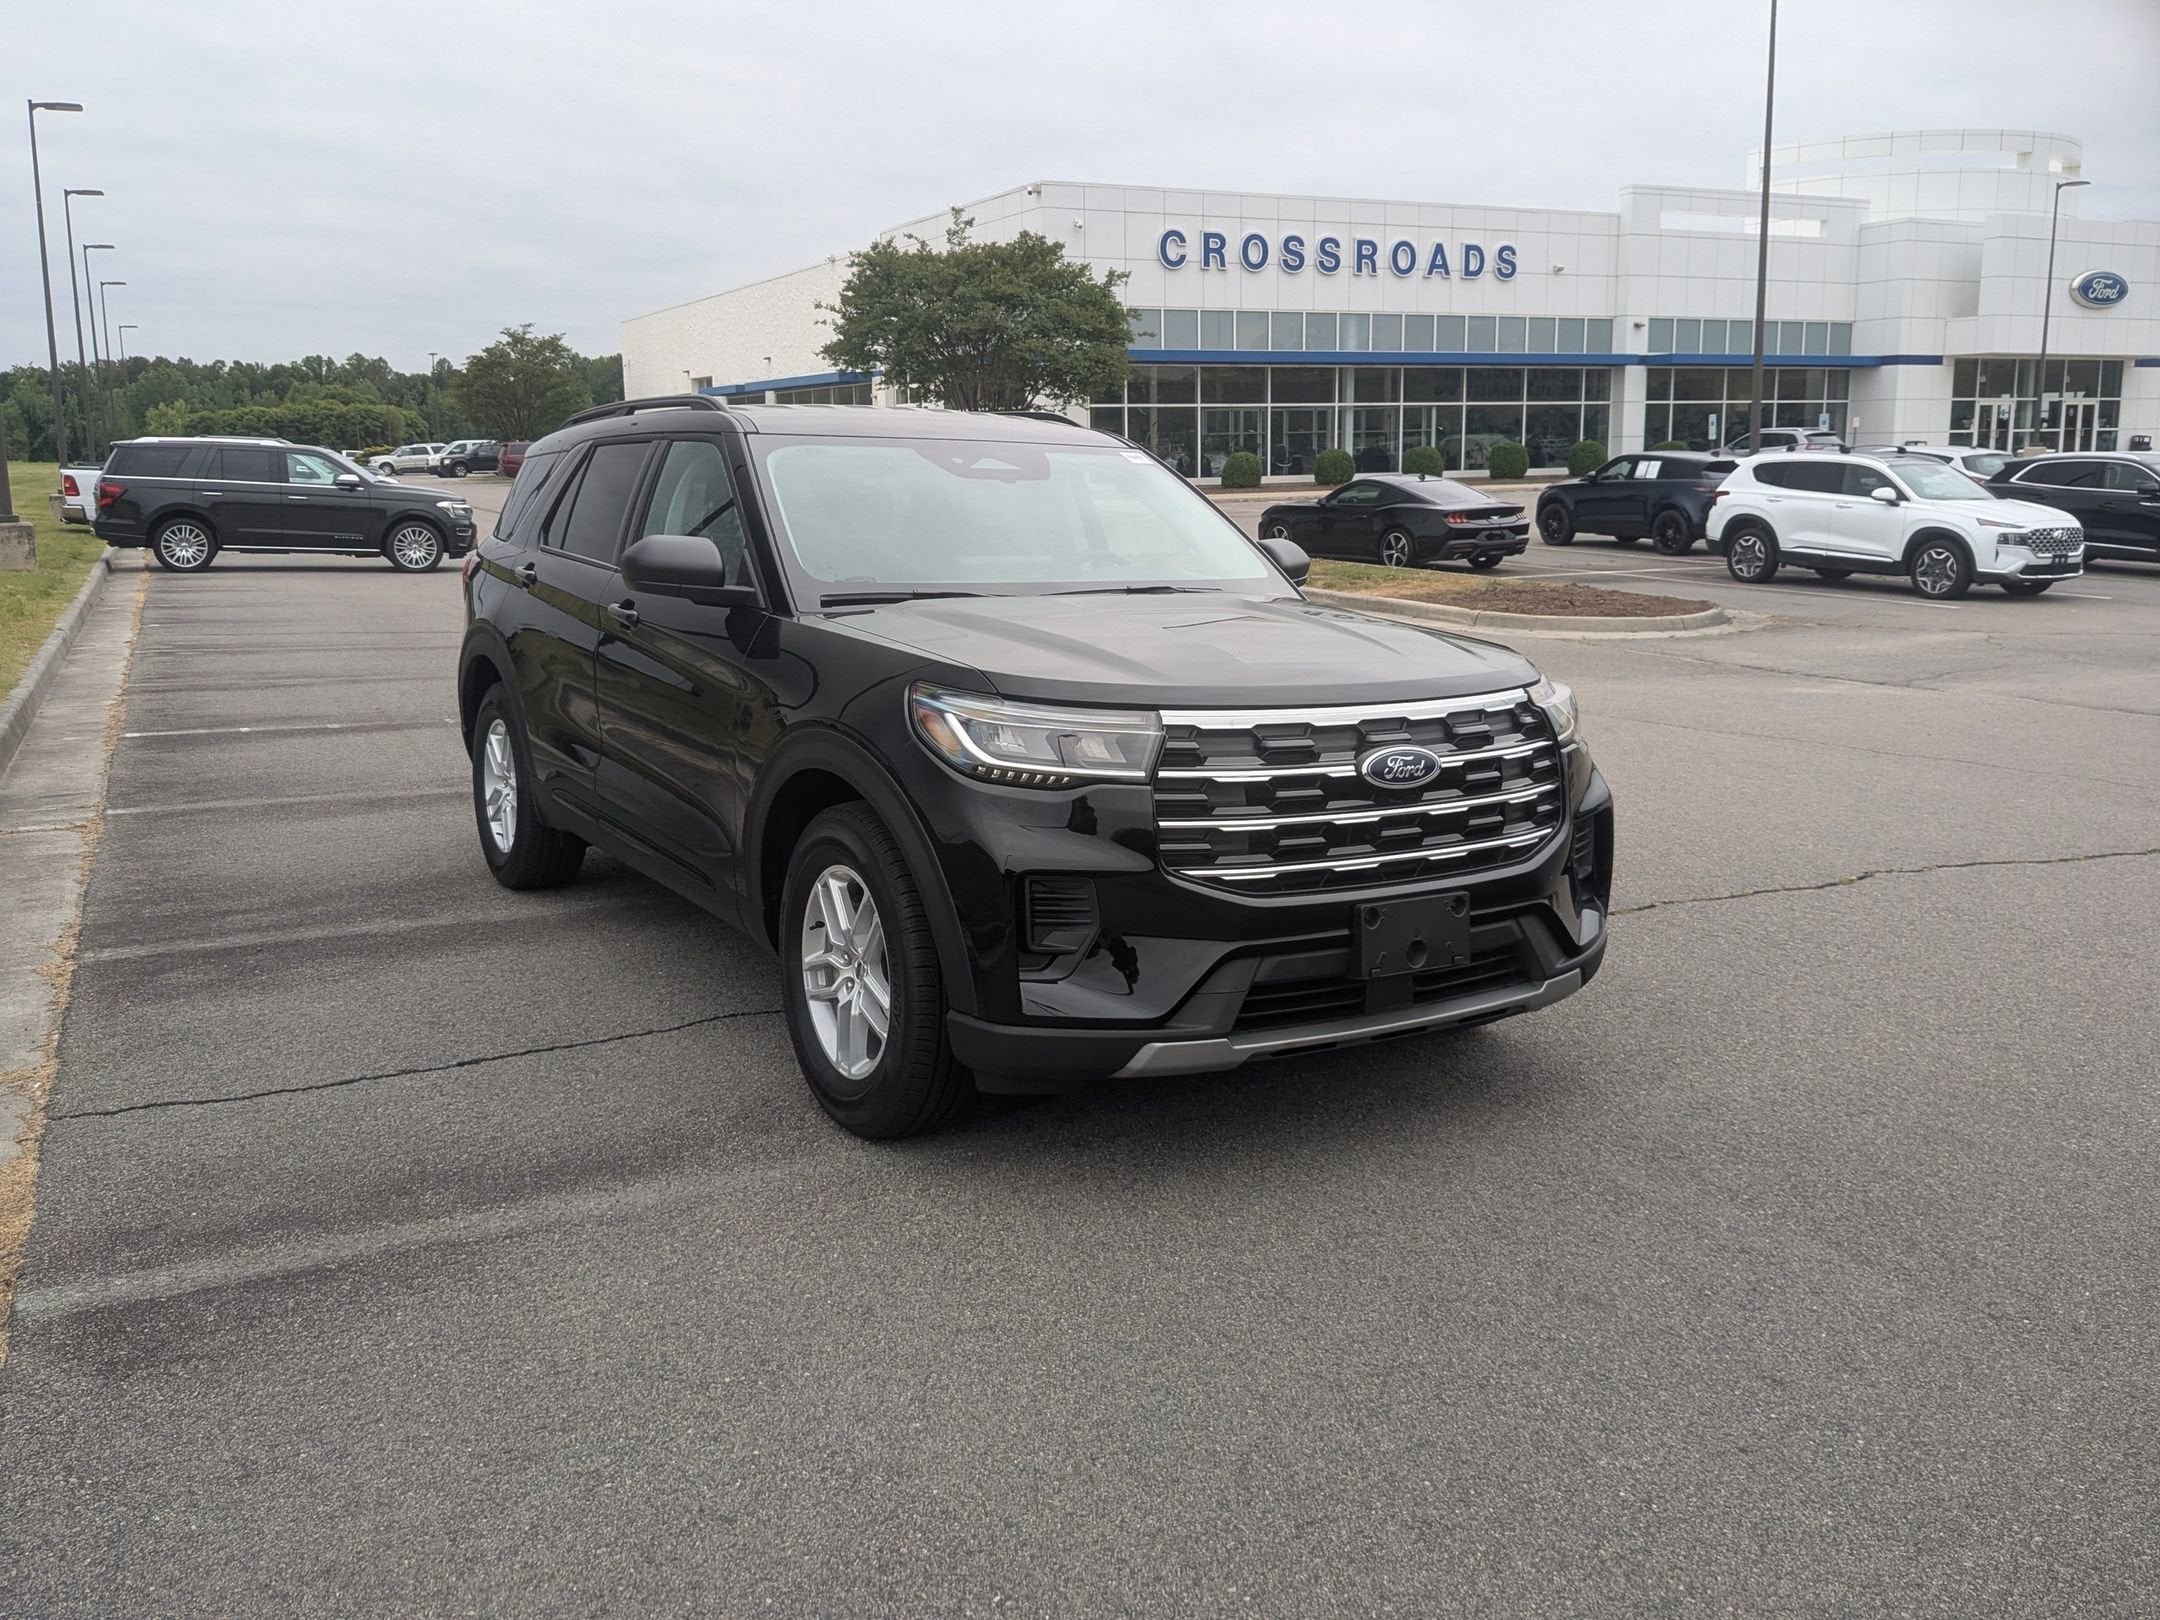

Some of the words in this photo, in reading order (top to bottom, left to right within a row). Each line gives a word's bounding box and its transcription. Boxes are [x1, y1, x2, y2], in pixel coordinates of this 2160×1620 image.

[1158, 227, 1518, 281] CROSSROADS
[2088, 278, 2120, 299] Ford
[1384, 755, 1425, 780] Ford
